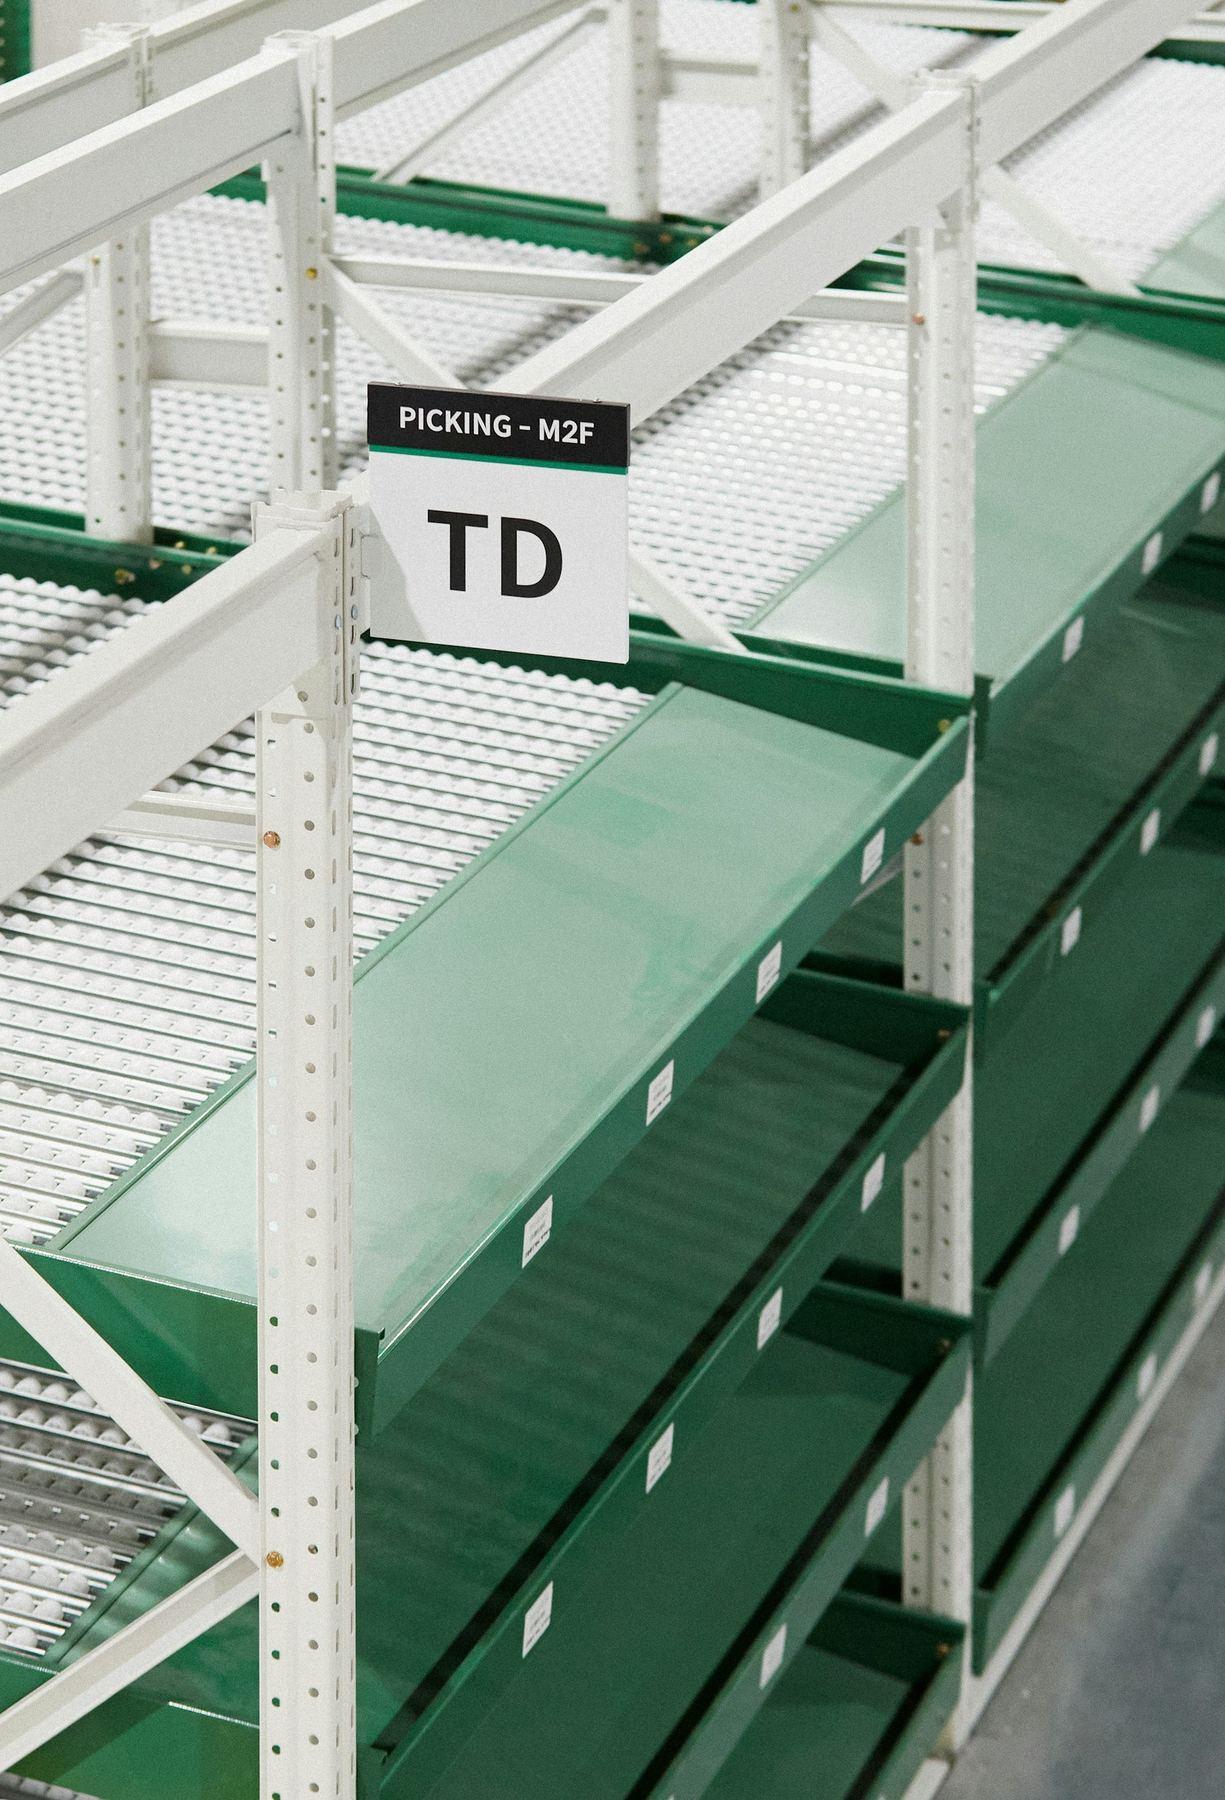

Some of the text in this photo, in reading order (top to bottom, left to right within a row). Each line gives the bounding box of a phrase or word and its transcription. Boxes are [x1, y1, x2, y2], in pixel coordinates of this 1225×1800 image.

[399, 406, 512, 438] PICKING
[539, 418, 594, 444] M2F
[427, 509, 563, 598] TD
